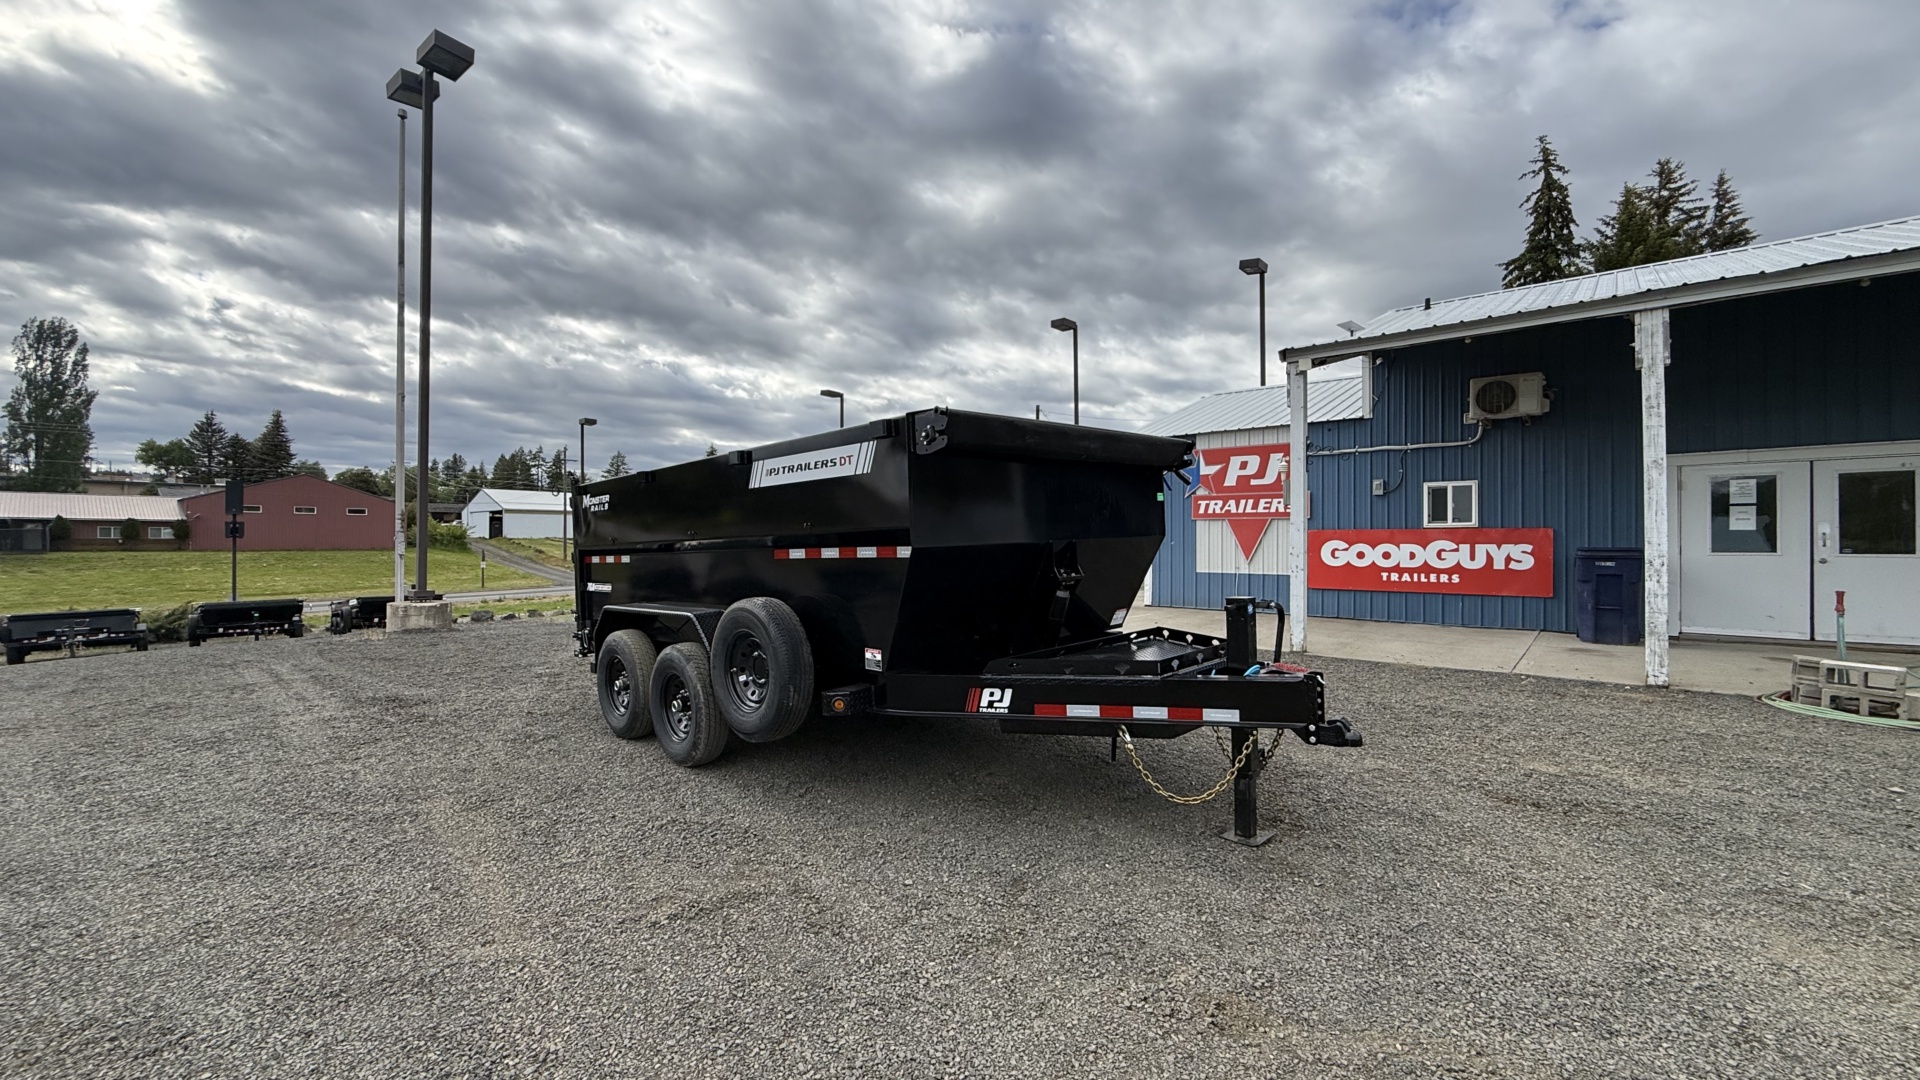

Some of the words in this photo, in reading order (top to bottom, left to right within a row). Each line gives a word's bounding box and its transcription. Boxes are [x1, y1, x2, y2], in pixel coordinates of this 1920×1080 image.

[839, 455, 854, 466] DT
[1223, 453, 1284, 486] PJ
[583, 494, 610, 508] MONSTER
[590, 503, 609, 512] RAILS
[1381, 572, 1460, 583] TRAILERS
[980, 688, 1013, 707] PJ
